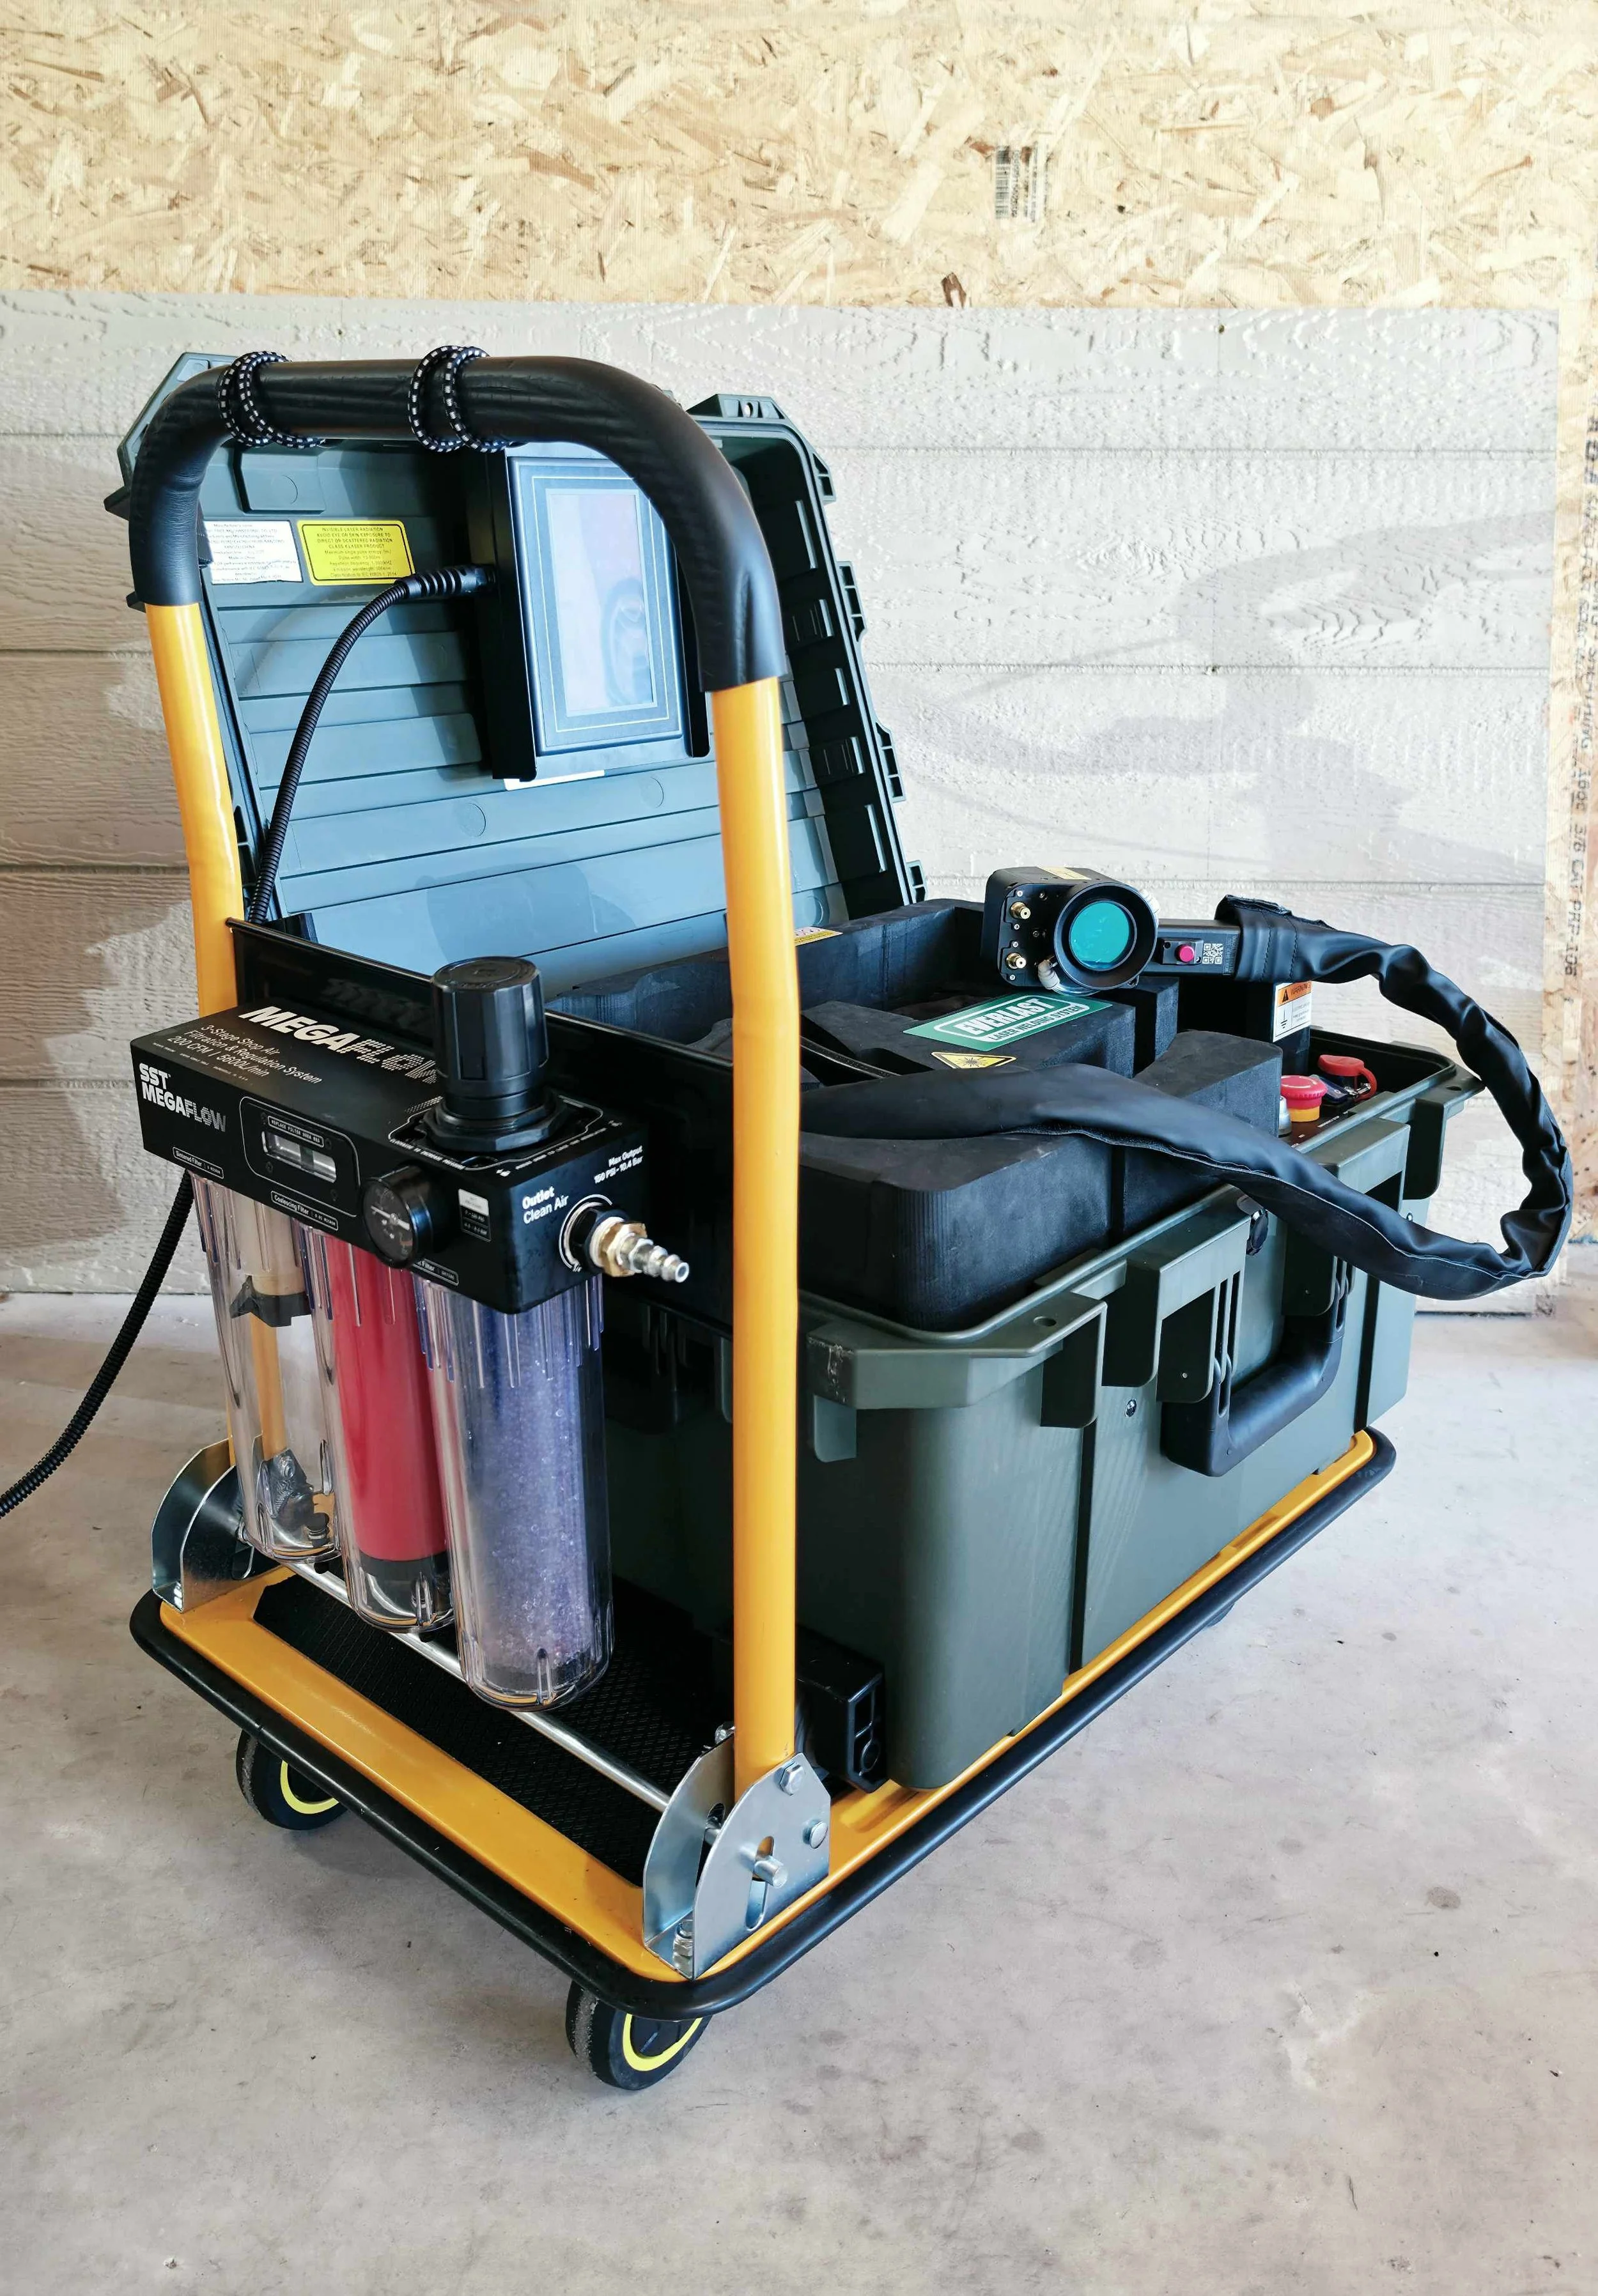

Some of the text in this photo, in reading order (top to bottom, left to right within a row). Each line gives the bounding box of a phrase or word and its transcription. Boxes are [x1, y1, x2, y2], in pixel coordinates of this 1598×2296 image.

[954, 998, 1055, 1035] EVERLAST
[987, 1005, 1085, 1041] LASER WELDING SYSTEM
[201, 1024, 240, 1041] 3-Stage
[237, 1038, 263, 1051] Shop
[167, 1036, 192, 1046] 200
[187, 1043, 213, 1054] CFM
[216, 1054, 270, 1077] 5600L/min
[184, 1029, 228, 1049] Filtration
[233, 1048, 286, 1070] Regulation
[283, 1067, 323, 1084] System
[139, 1063, 169, 1090] SST
[141, 1081, 226, 1132] MEGAFLOW
[192, 1157, 202, 1167] Filter
[594, 1171, 605, 1184] 150
[605, 1168, 617, 1179] PSI
[619, 1159, 632, 1172] 10.4
[632, 1155, 643, 1166] Bar
[609, 1145, 643, 1167] Max Output
[274, 1194, 298, 1211] Coalescing
[297, 1205, 309, 1215] Filter
[522, 1185, 555, 1210] Outlet
[524, 1194, 569, 1224] Clean Air
